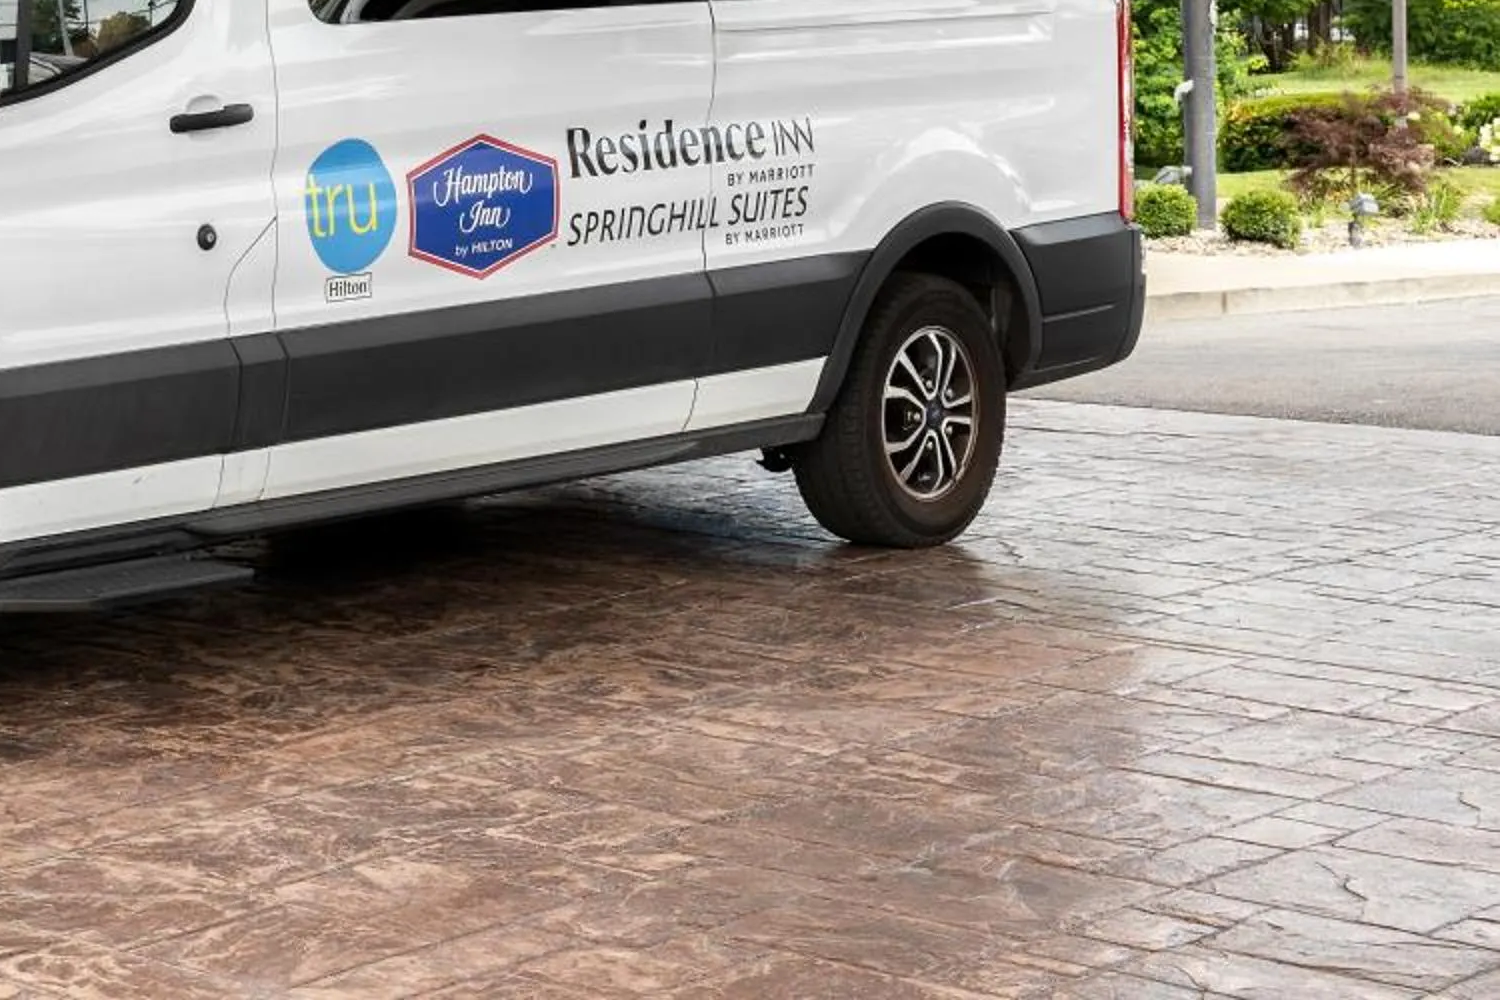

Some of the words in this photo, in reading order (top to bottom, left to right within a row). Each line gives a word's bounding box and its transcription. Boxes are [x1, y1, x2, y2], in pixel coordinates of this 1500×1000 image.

[565, 118, 767, 179] Residence
[771, 116, 816, 157] INN
[432, 164, 534, 207] Hampton
[726, 172, 745, 187] BY
[749, 163, 816, 185] MARRIOTT
[299, 173, 379, 238] tru
[459, 199, 511, 233] Inn
[566, 195, 720, 247] SPRINGHILL
[727, 185, 810, 227] SUITES
[454, 243, 468, 258] by
[471, 238, 513, 254] HILTON
[725, 232, 740, 245] BY
[744, 223, 805, 243] MARRIOTT
[328, 280, 368, 298] Hilton
